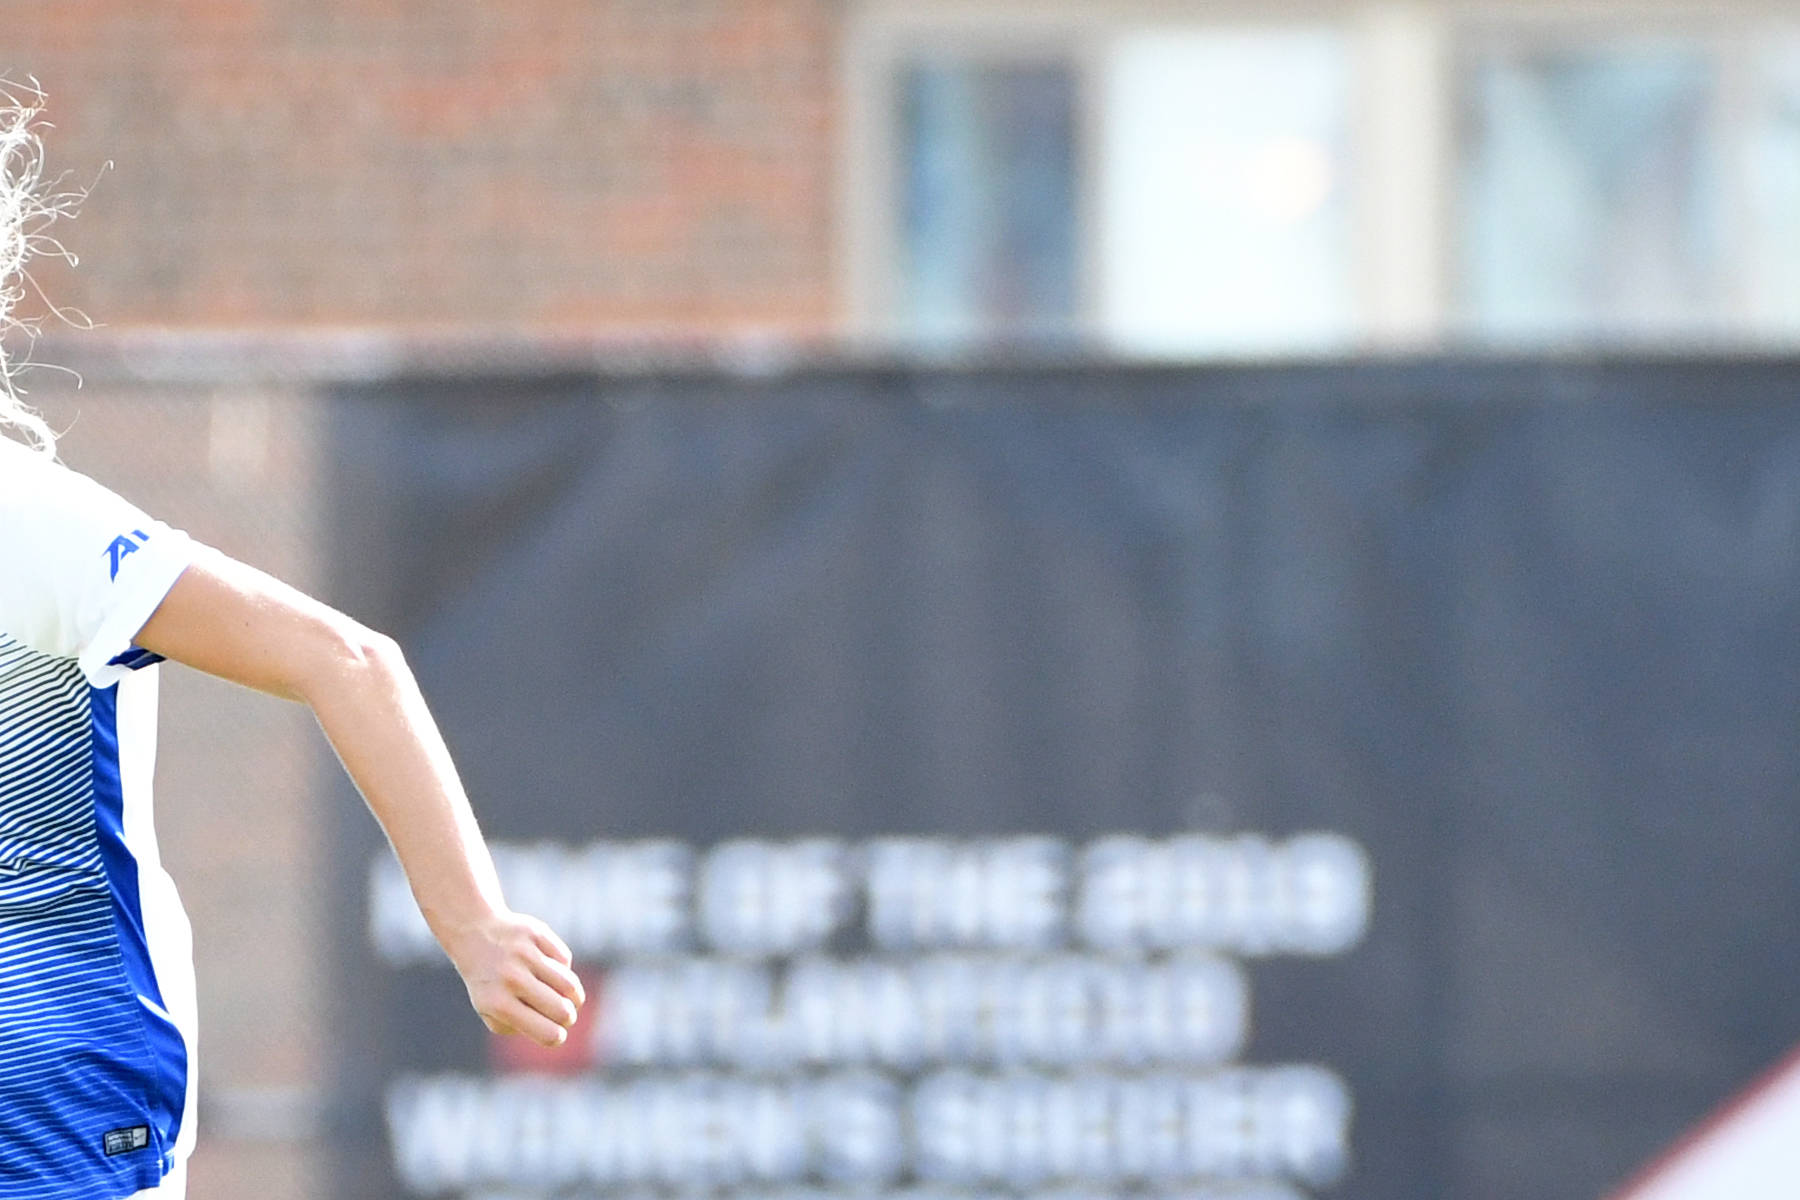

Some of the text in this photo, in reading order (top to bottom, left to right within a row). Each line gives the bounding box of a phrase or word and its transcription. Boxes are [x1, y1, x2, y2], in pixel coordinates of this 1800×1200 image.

[702, 838, 845, 954] OF
[869, 837, 1066, 950] THE
[1082, 836, 1368, 953] 2019
[389, 1069, 1350, 1190] WOMEN'S SOCCER
